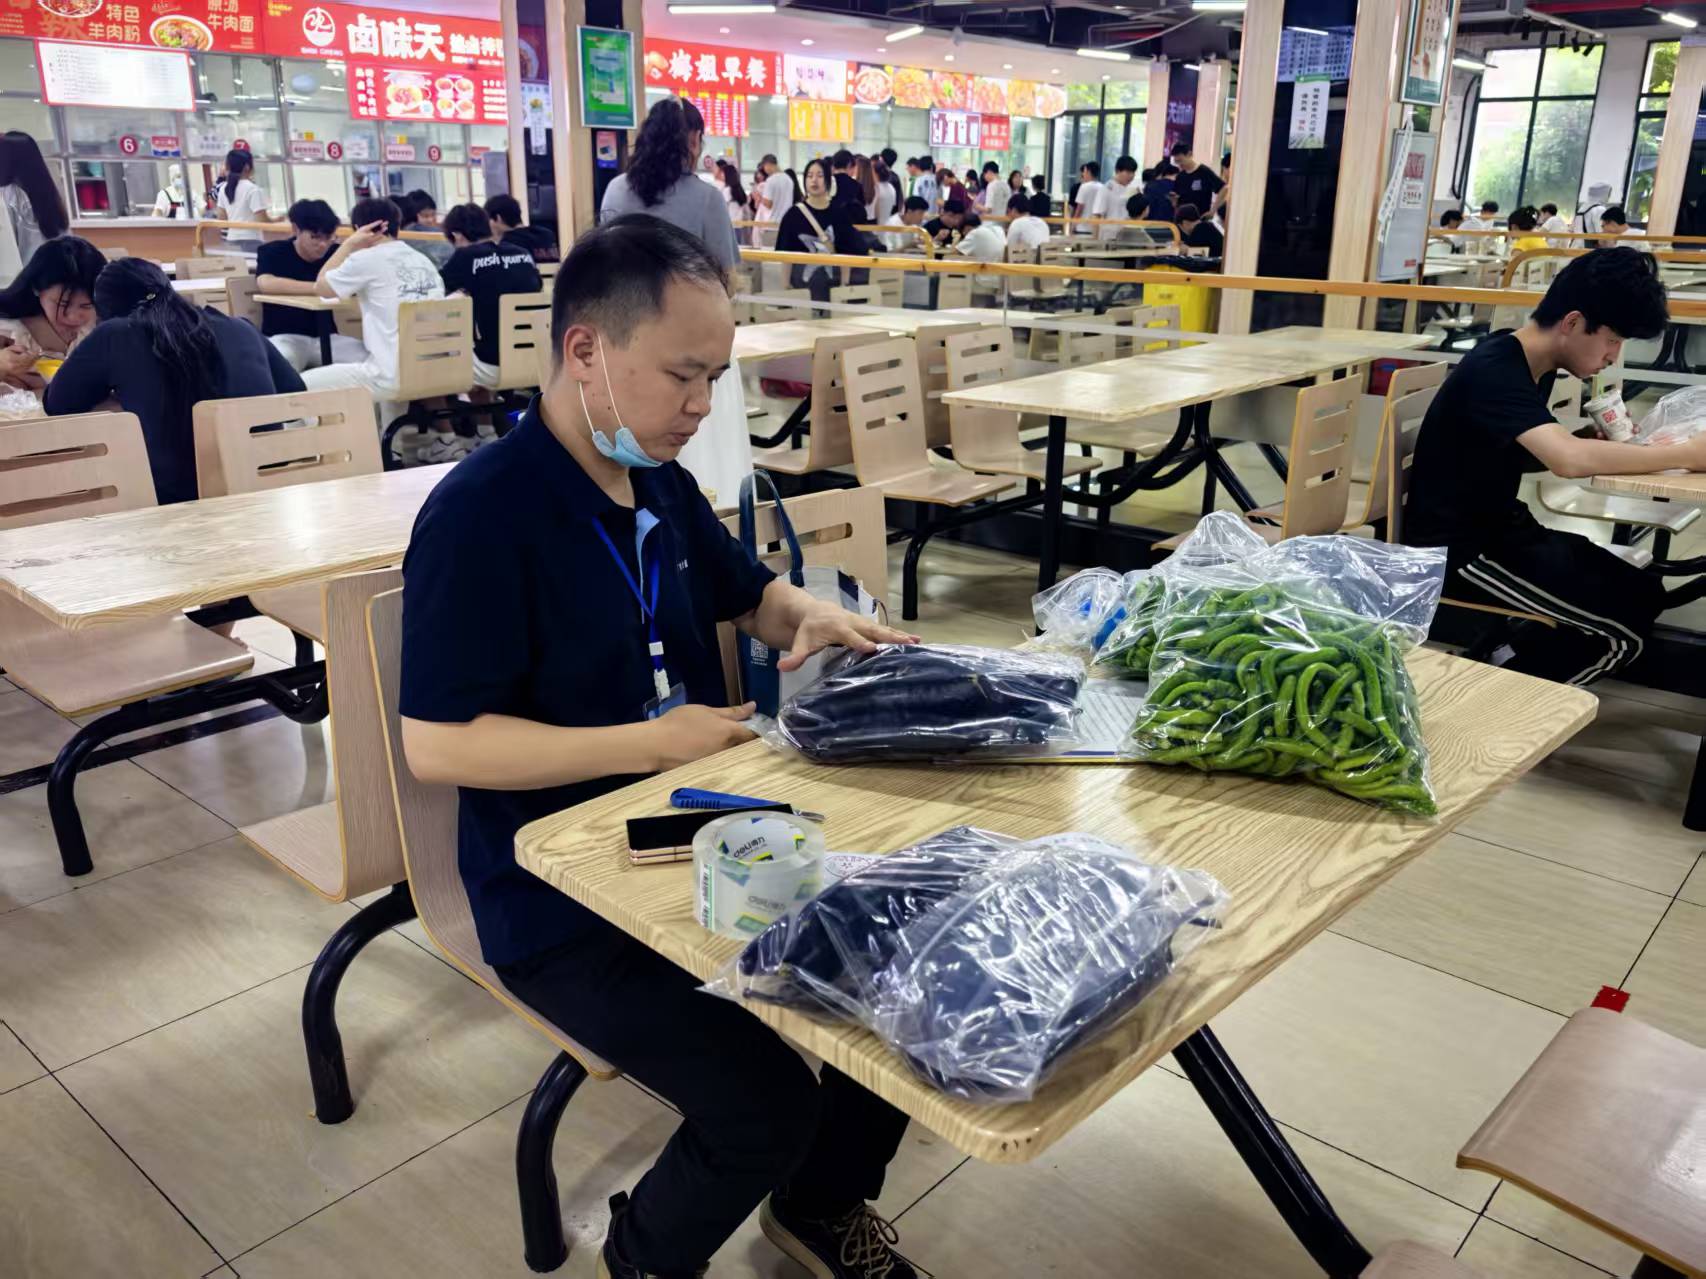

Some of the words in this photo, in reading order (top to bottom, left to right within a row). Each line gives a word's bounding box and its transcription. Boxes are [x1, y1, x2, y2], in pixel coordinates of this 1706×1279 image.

[106, 3, 140, 23] 特色
[207, 13, 254, 32] 牛肉面
[124, 138, 134, 153] 6
[331, 143, 339, 157] 8
[430, 147, 438, 160] 9
[472, 252, 501, 275] push
